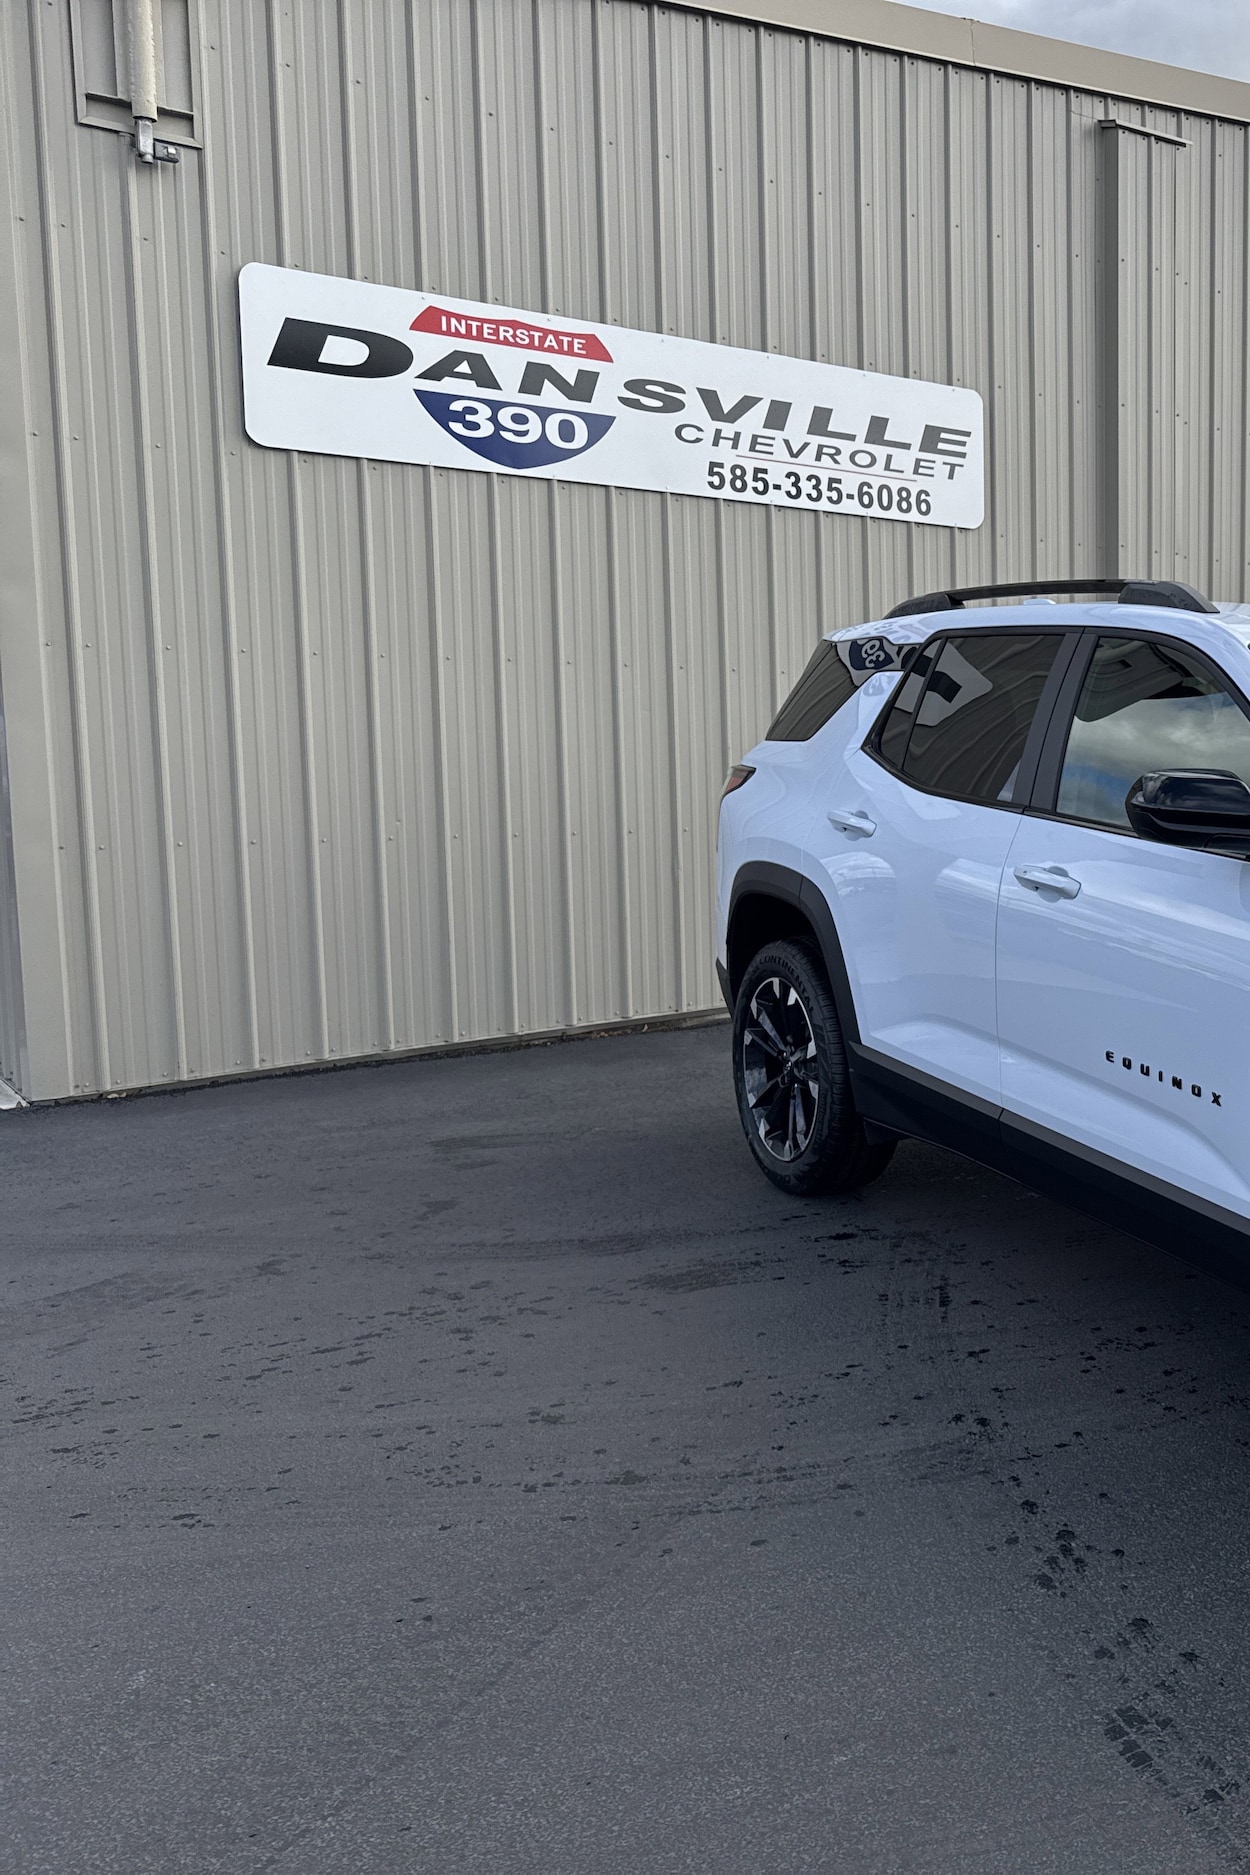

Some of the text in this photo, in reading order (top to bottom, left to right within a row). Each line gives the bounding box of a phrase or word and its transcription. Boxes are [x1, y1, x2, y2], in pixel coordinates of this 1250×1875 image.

[440, 315, 588, 355] INTERSTATE
[267, 317, 972, 459] DANSVILLE
[448, 401, 590, 449] 390
[674, 425, 965, 481] CHEVROLET
[707, 462, 932, 516] 585-335-6086
[1105, 1050, 1222, 1107] EQUINOX
